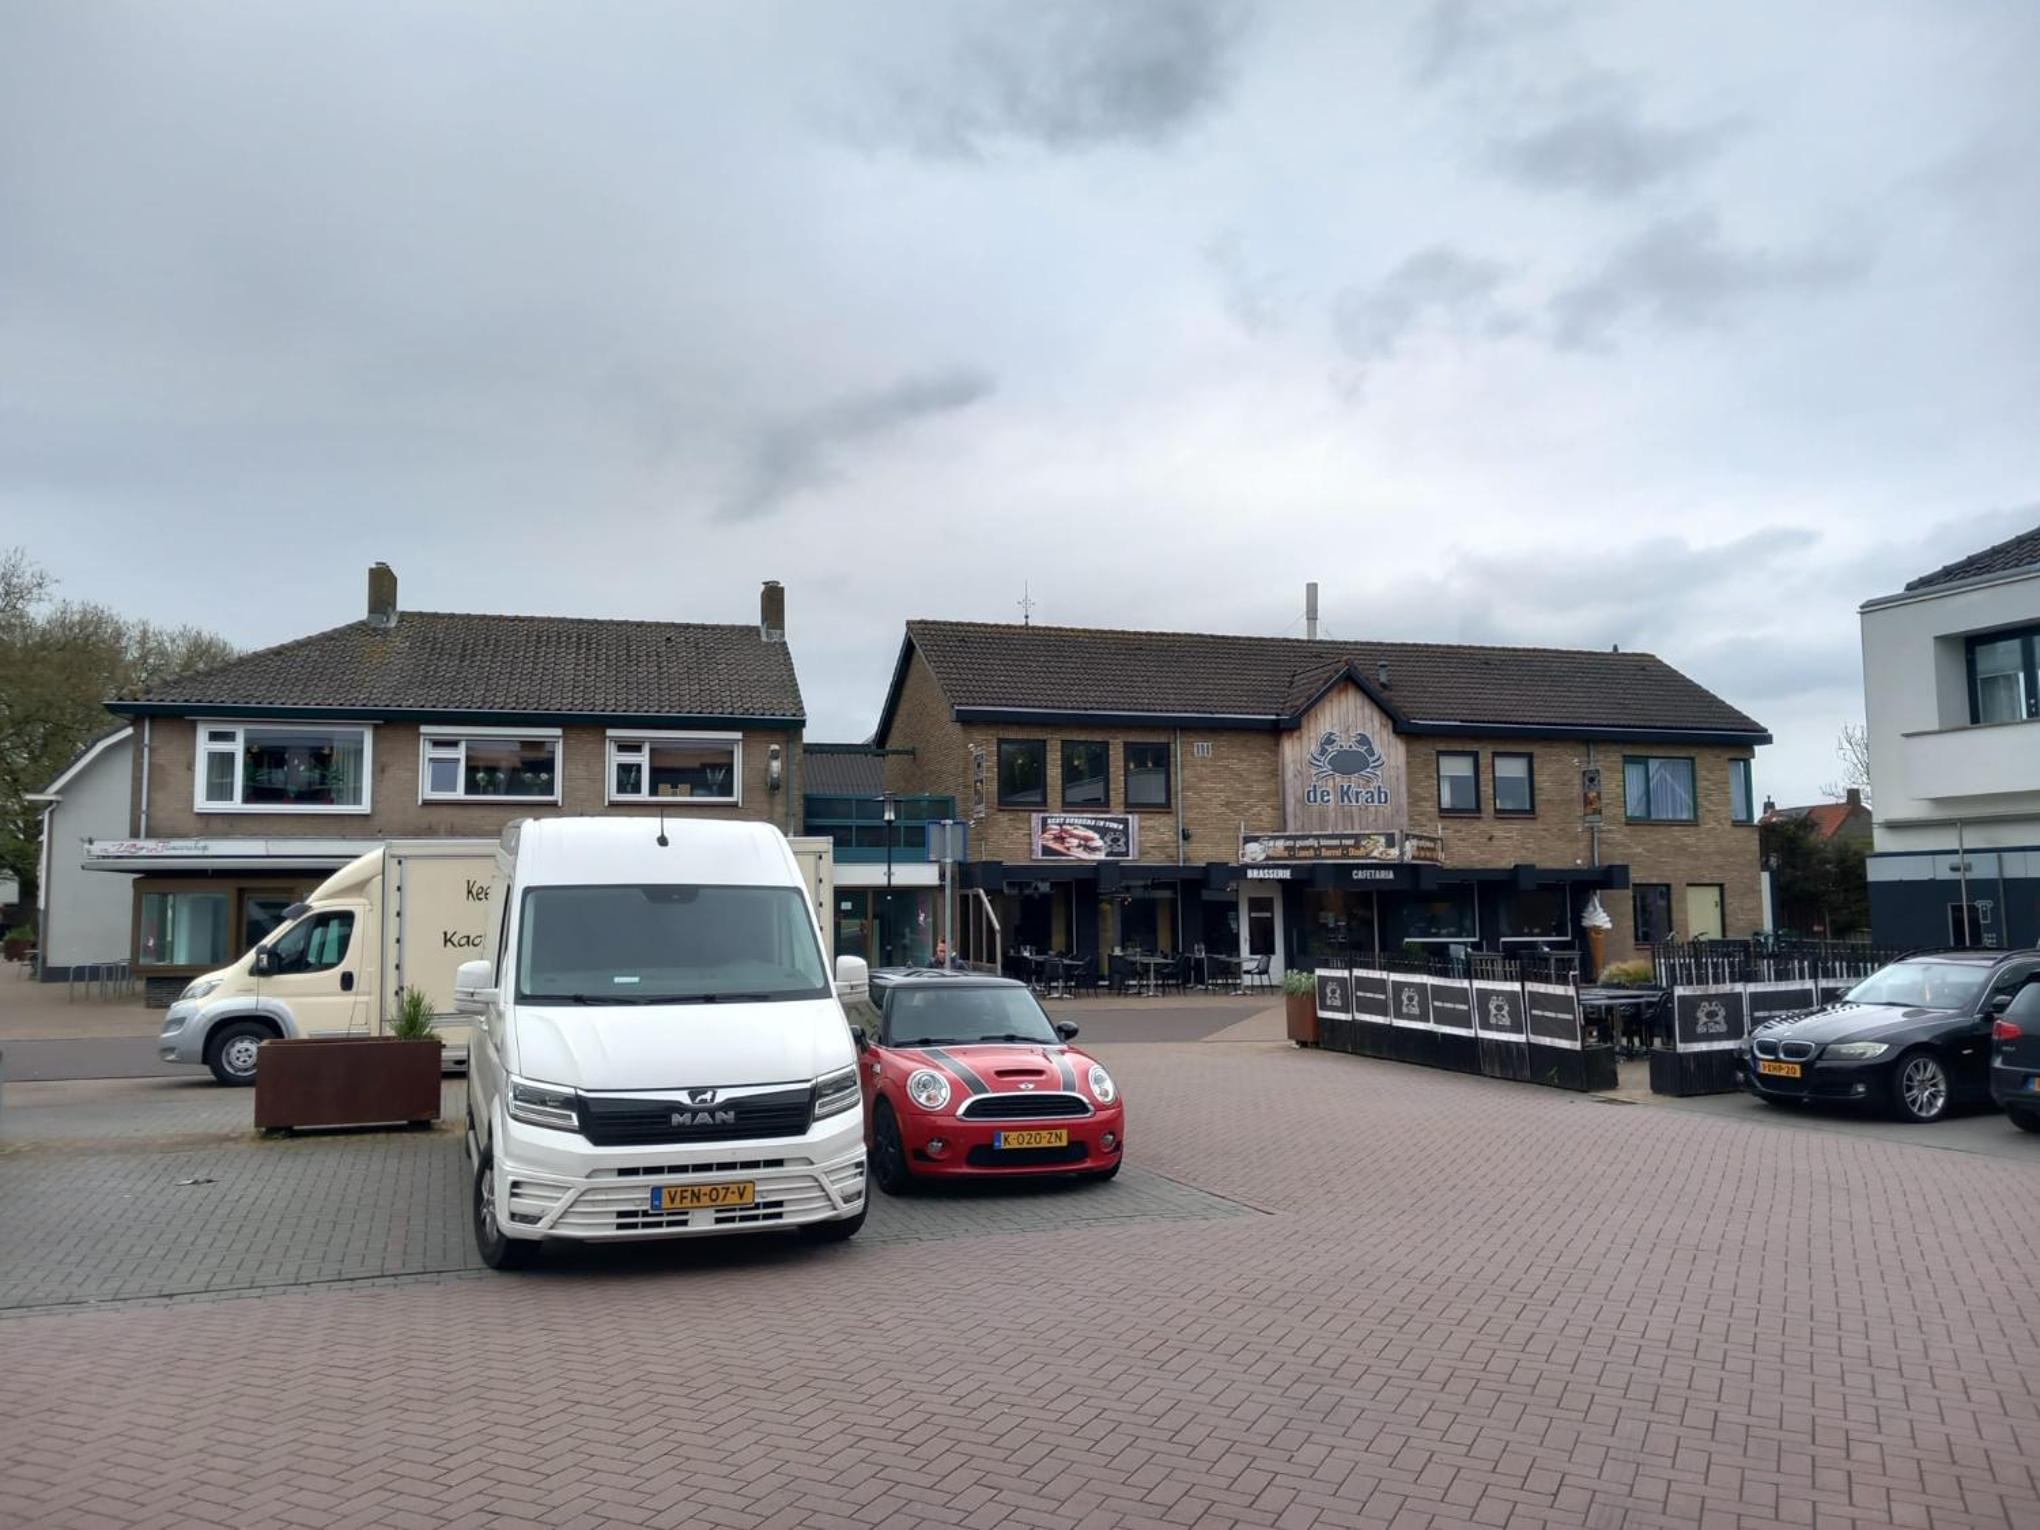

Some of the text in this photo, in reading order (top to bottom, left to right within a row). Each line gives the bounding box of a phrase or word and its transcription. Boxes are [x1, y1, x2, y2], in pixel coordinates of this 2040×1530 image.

[1306, 783, 1389, 805] de Krab
[1246, 868, 1292, 880] BRASSERIE
[1351, 869, 1395, 880] CAFETARIA
[671, 1110, 735, 1127] MAN
[1003, 1131, 1063, 1146] K-020-ZN
[667, 1185, 747, 1205] VFN-07-V
